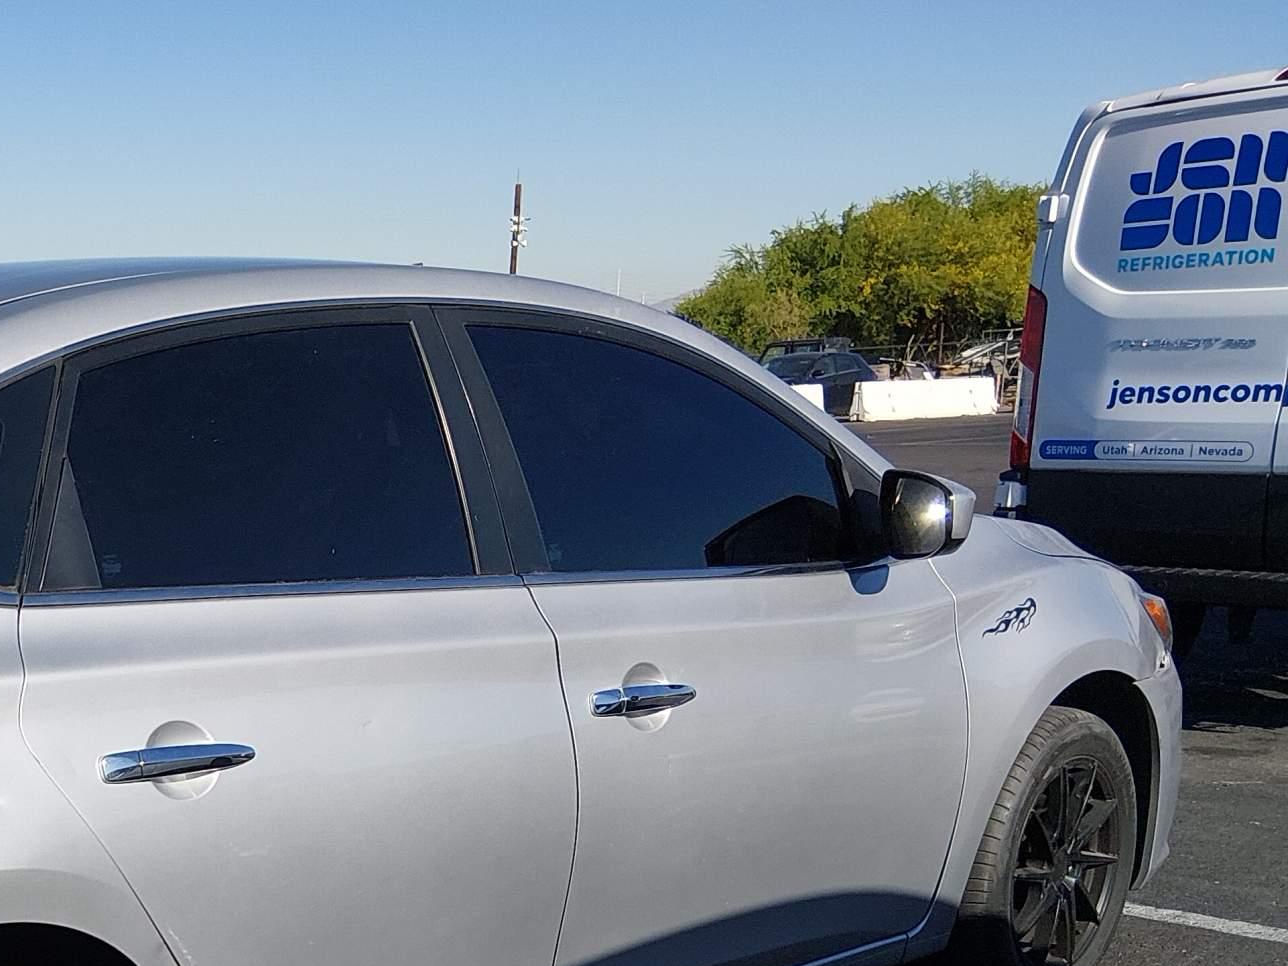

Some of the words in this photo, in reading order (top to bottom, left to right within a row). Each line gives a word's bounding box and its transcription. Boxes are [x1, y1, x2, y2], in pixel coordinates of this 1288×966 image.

[1120, 187, 1281, 251] SON
[1117, 248, 1275, 273] REFRIGERATION
[1107, 379, 1288, 409] jensoncom
[1045, 445, 1088, 455] SERVING
[1102, 445, 1128, 456] Utah
[1140, 446, 1185, 456] Arizona
[1198, 446, 1244, 457] Nevada
